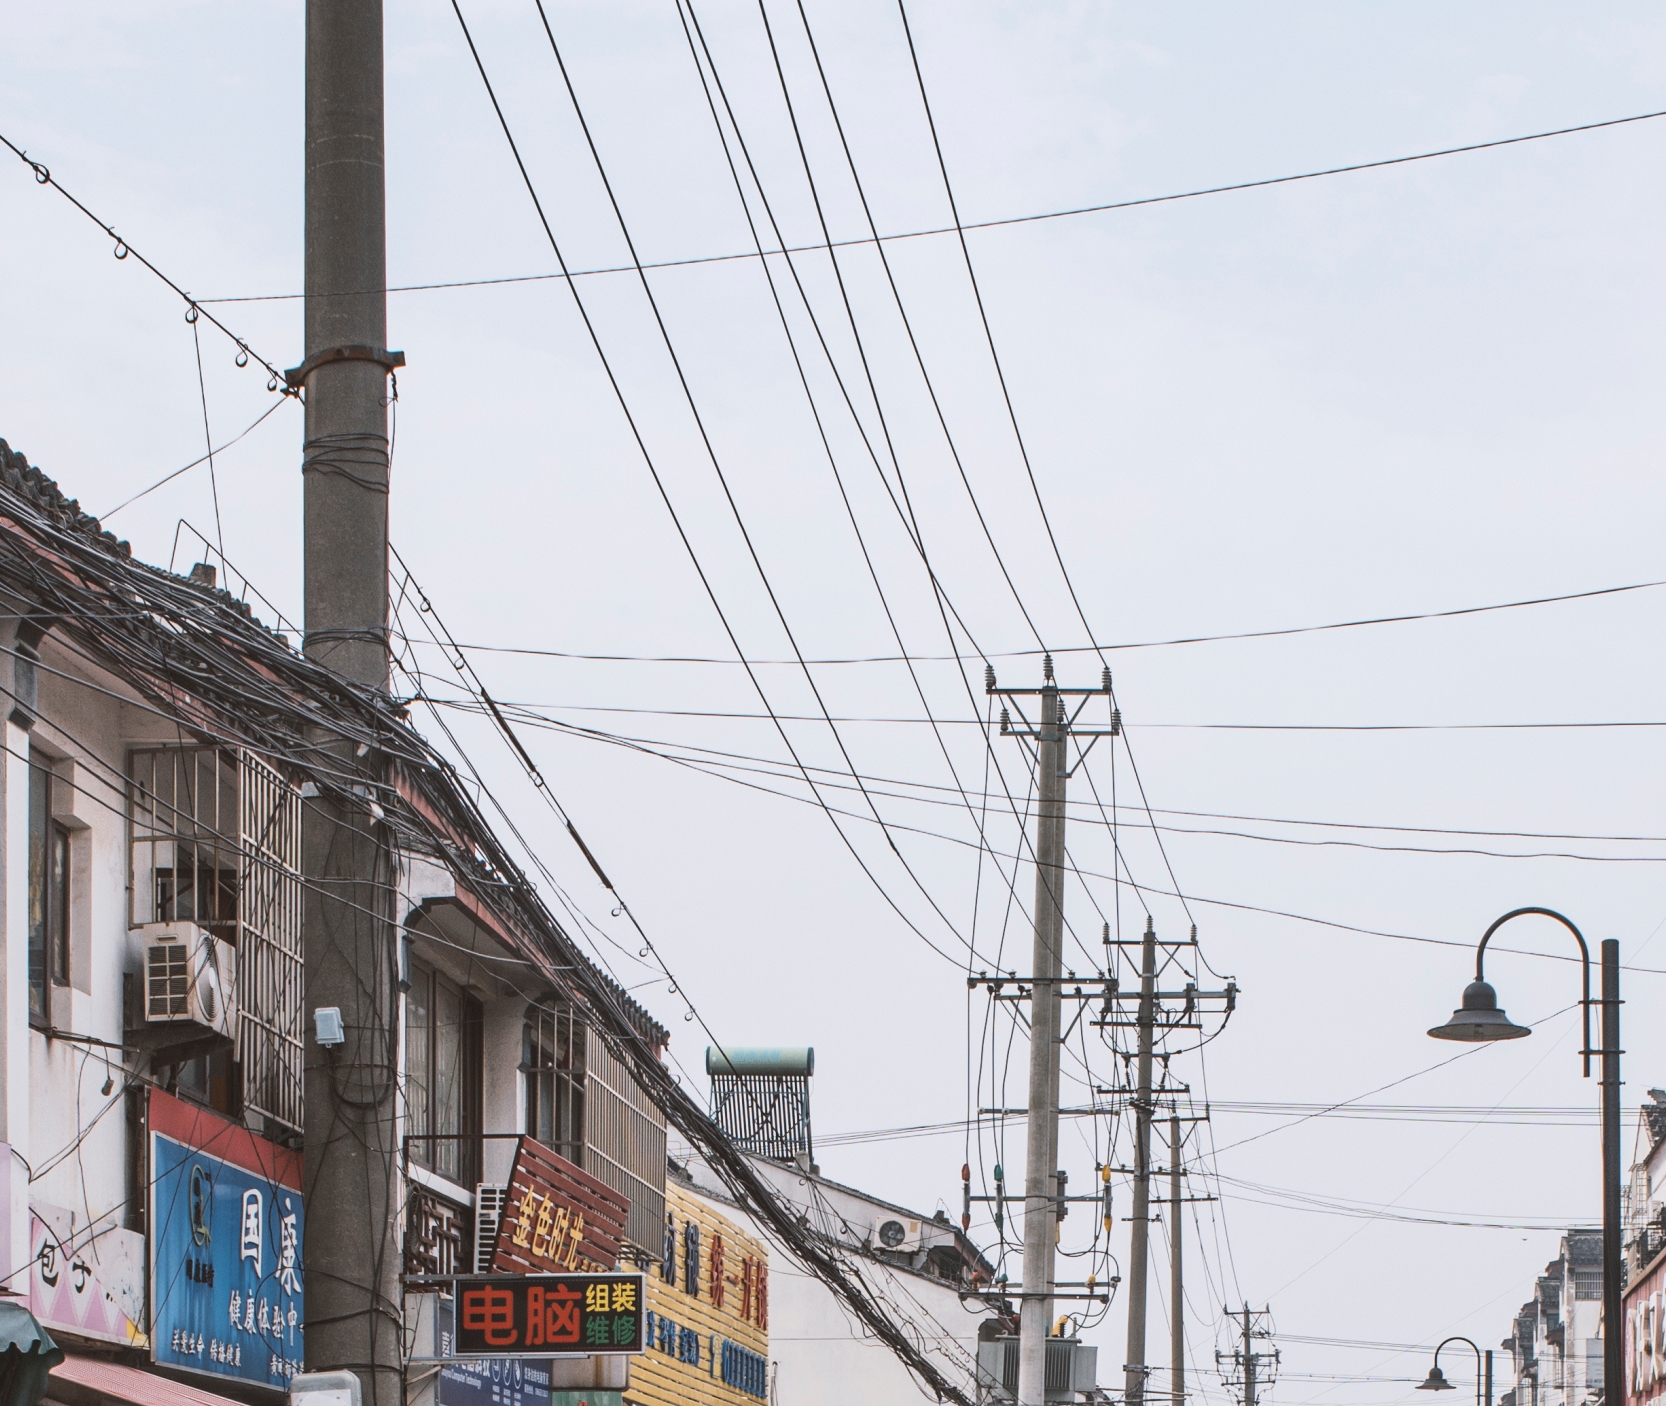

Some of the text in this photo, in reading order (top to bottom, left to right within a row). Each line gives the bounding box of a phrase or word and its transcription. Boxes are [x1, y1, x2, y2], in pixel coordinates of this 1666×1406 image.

[511, 1184, 584, 1273] 金色时光
[463, 1284, 583, 1347] 电脑
[585, 1283, 636, 1313] 组装
[585, 1315, 636, 1346] 维修
